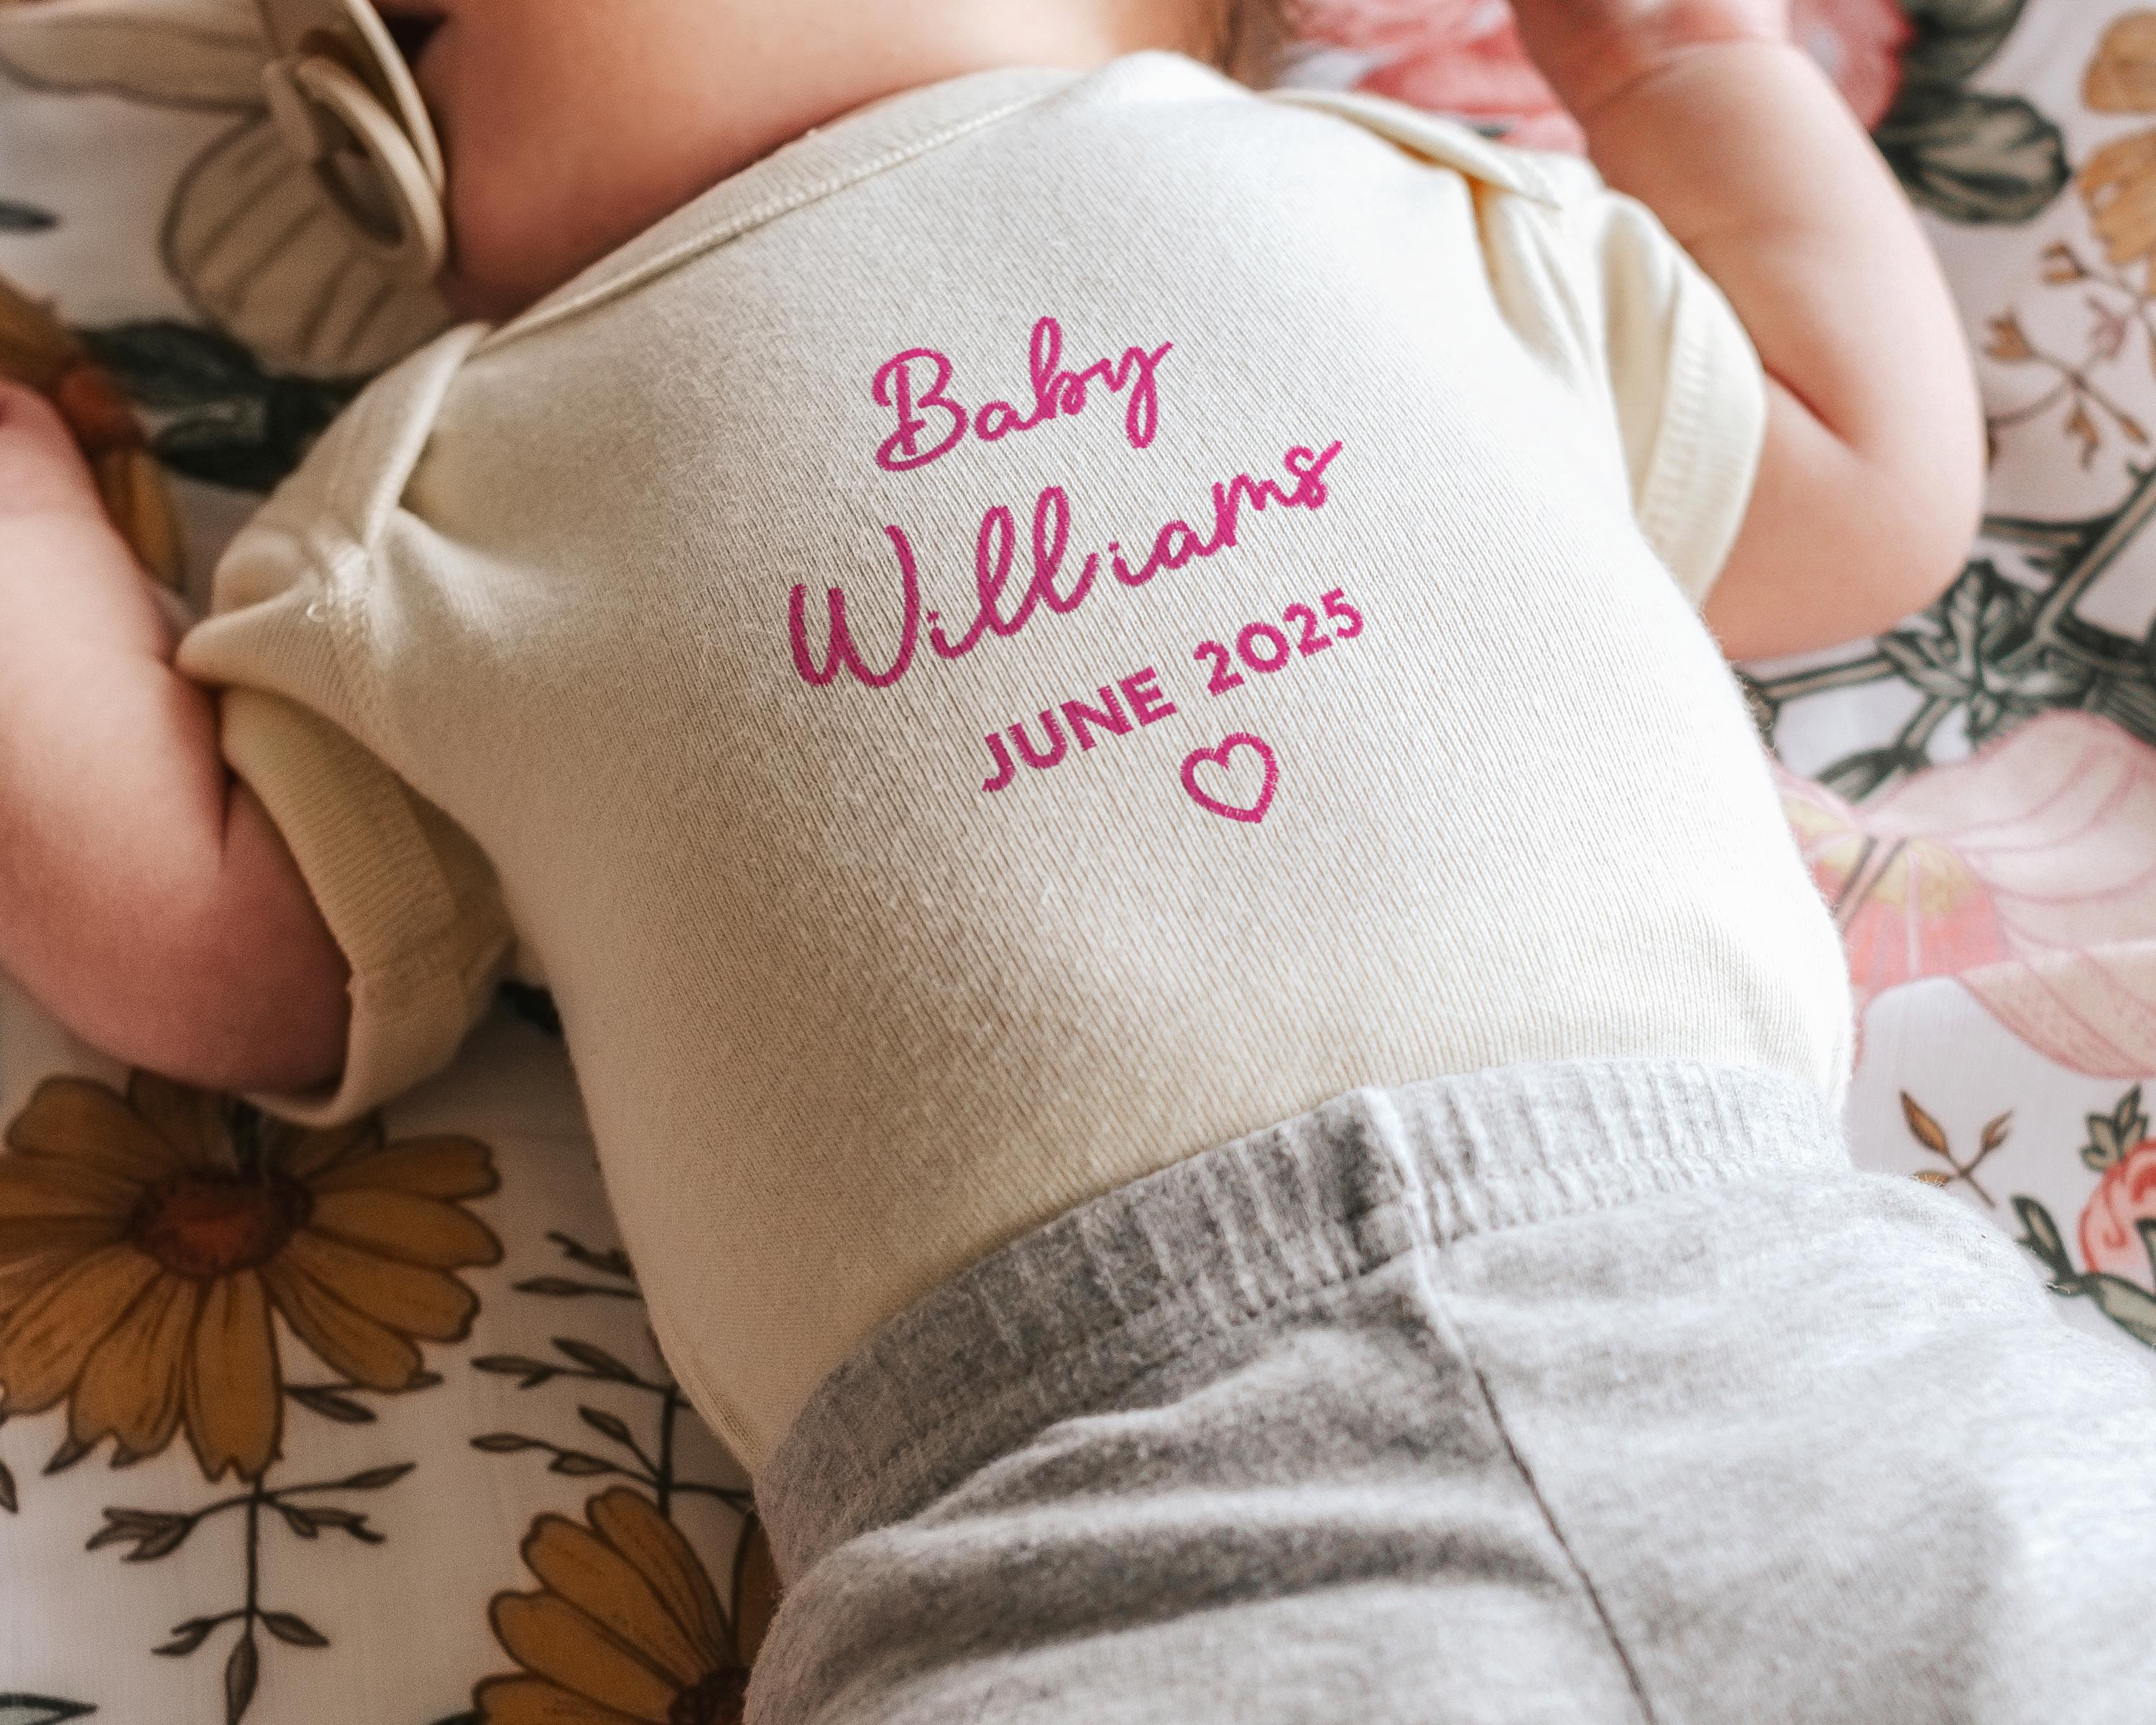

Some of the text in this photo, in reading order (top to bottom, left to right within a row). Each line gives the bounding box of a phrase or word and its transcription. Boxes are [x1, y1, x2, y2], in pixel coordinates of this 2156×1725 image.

[872, 316, 1174, 472] Baby
[788, 441, 1343, 688] Williams
[982, 587, 1364, 792] JUNE 2025
